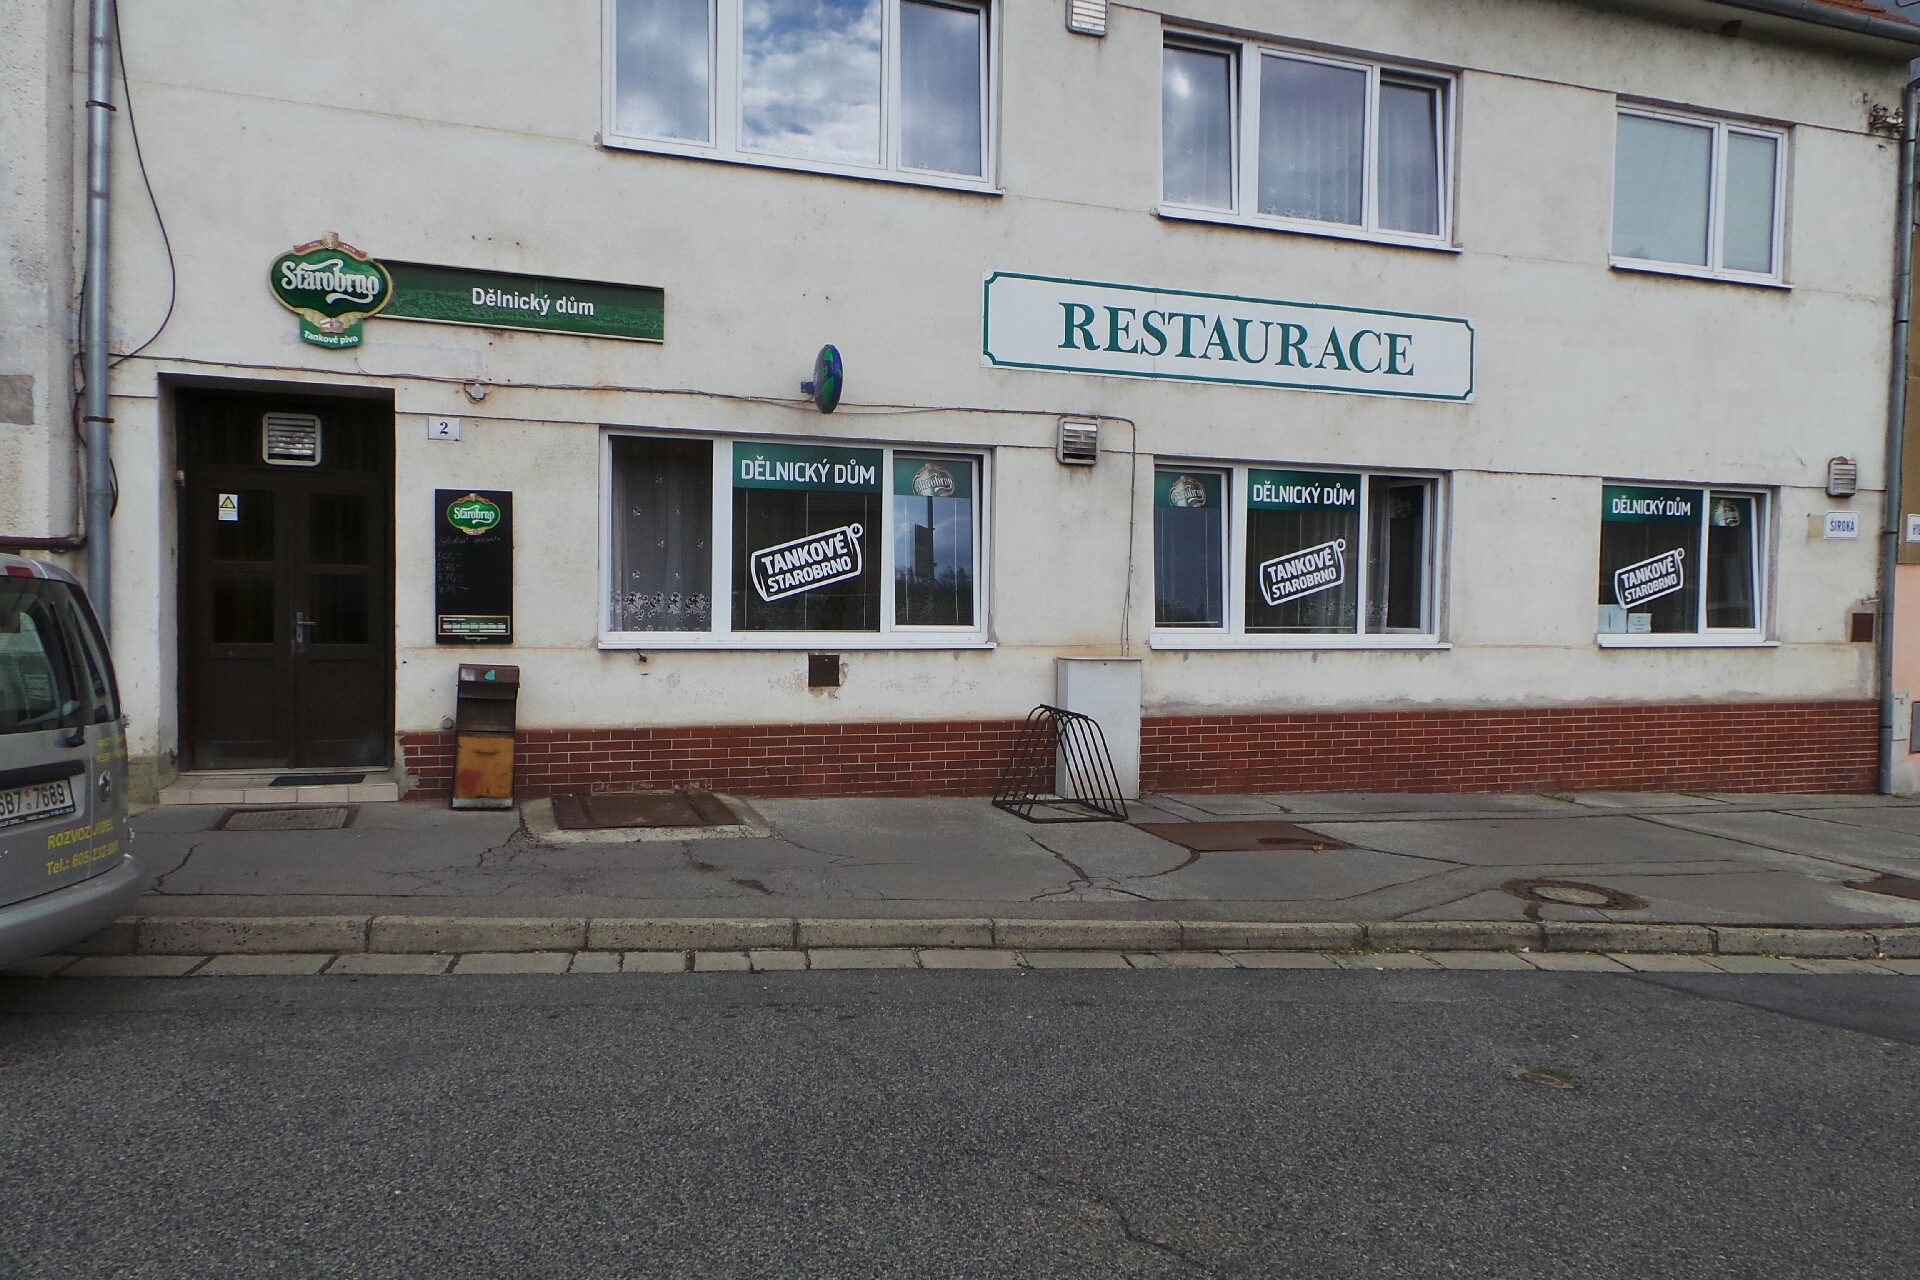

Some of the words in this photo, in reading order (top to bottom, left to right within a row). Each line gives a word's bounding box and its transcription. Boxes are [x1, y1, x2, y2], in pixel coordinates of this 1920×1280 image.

[281, 259, 380, 304] Starobrno
[472, 287, 550, 316] Dělnický
[555, 296, 594, 316] dům
[304, 330, 339, 344] Tankové
[340, 335, 359, 345] pivo
[1058, 302, 1414, 376] RESTAURACE
[439, 421, 449, 435] 2
[741, 454, 831, 483] DĚLNICKÝ
[834, 458, 876, 485] DŮM
[1252, 480, 1321, 504] DĚLNICKÝ
[1323, 482, 1356, 506] DŮM
[1612, 494, 1666, 515] DĚLNICKÝ
[1666, 496, 1691, 516] DŮM
[453, 504, 495, 525] Starobrno
[760, 533, 848, 576] TANKOVÉ
[1267, 547, 1334, 583] TANKOVÉ
[767, 556, 852, 593] STAROBRNO
[1271, 567, 1337, 598] STAROBRNO
[1620, 555, 1676, 589] TANKOVÉ
[1624, 573, 1677, 602] STAROBRNO
[33, 783, 66, 809] 7689
[47, 825, 91, 850] ROZVOZ
